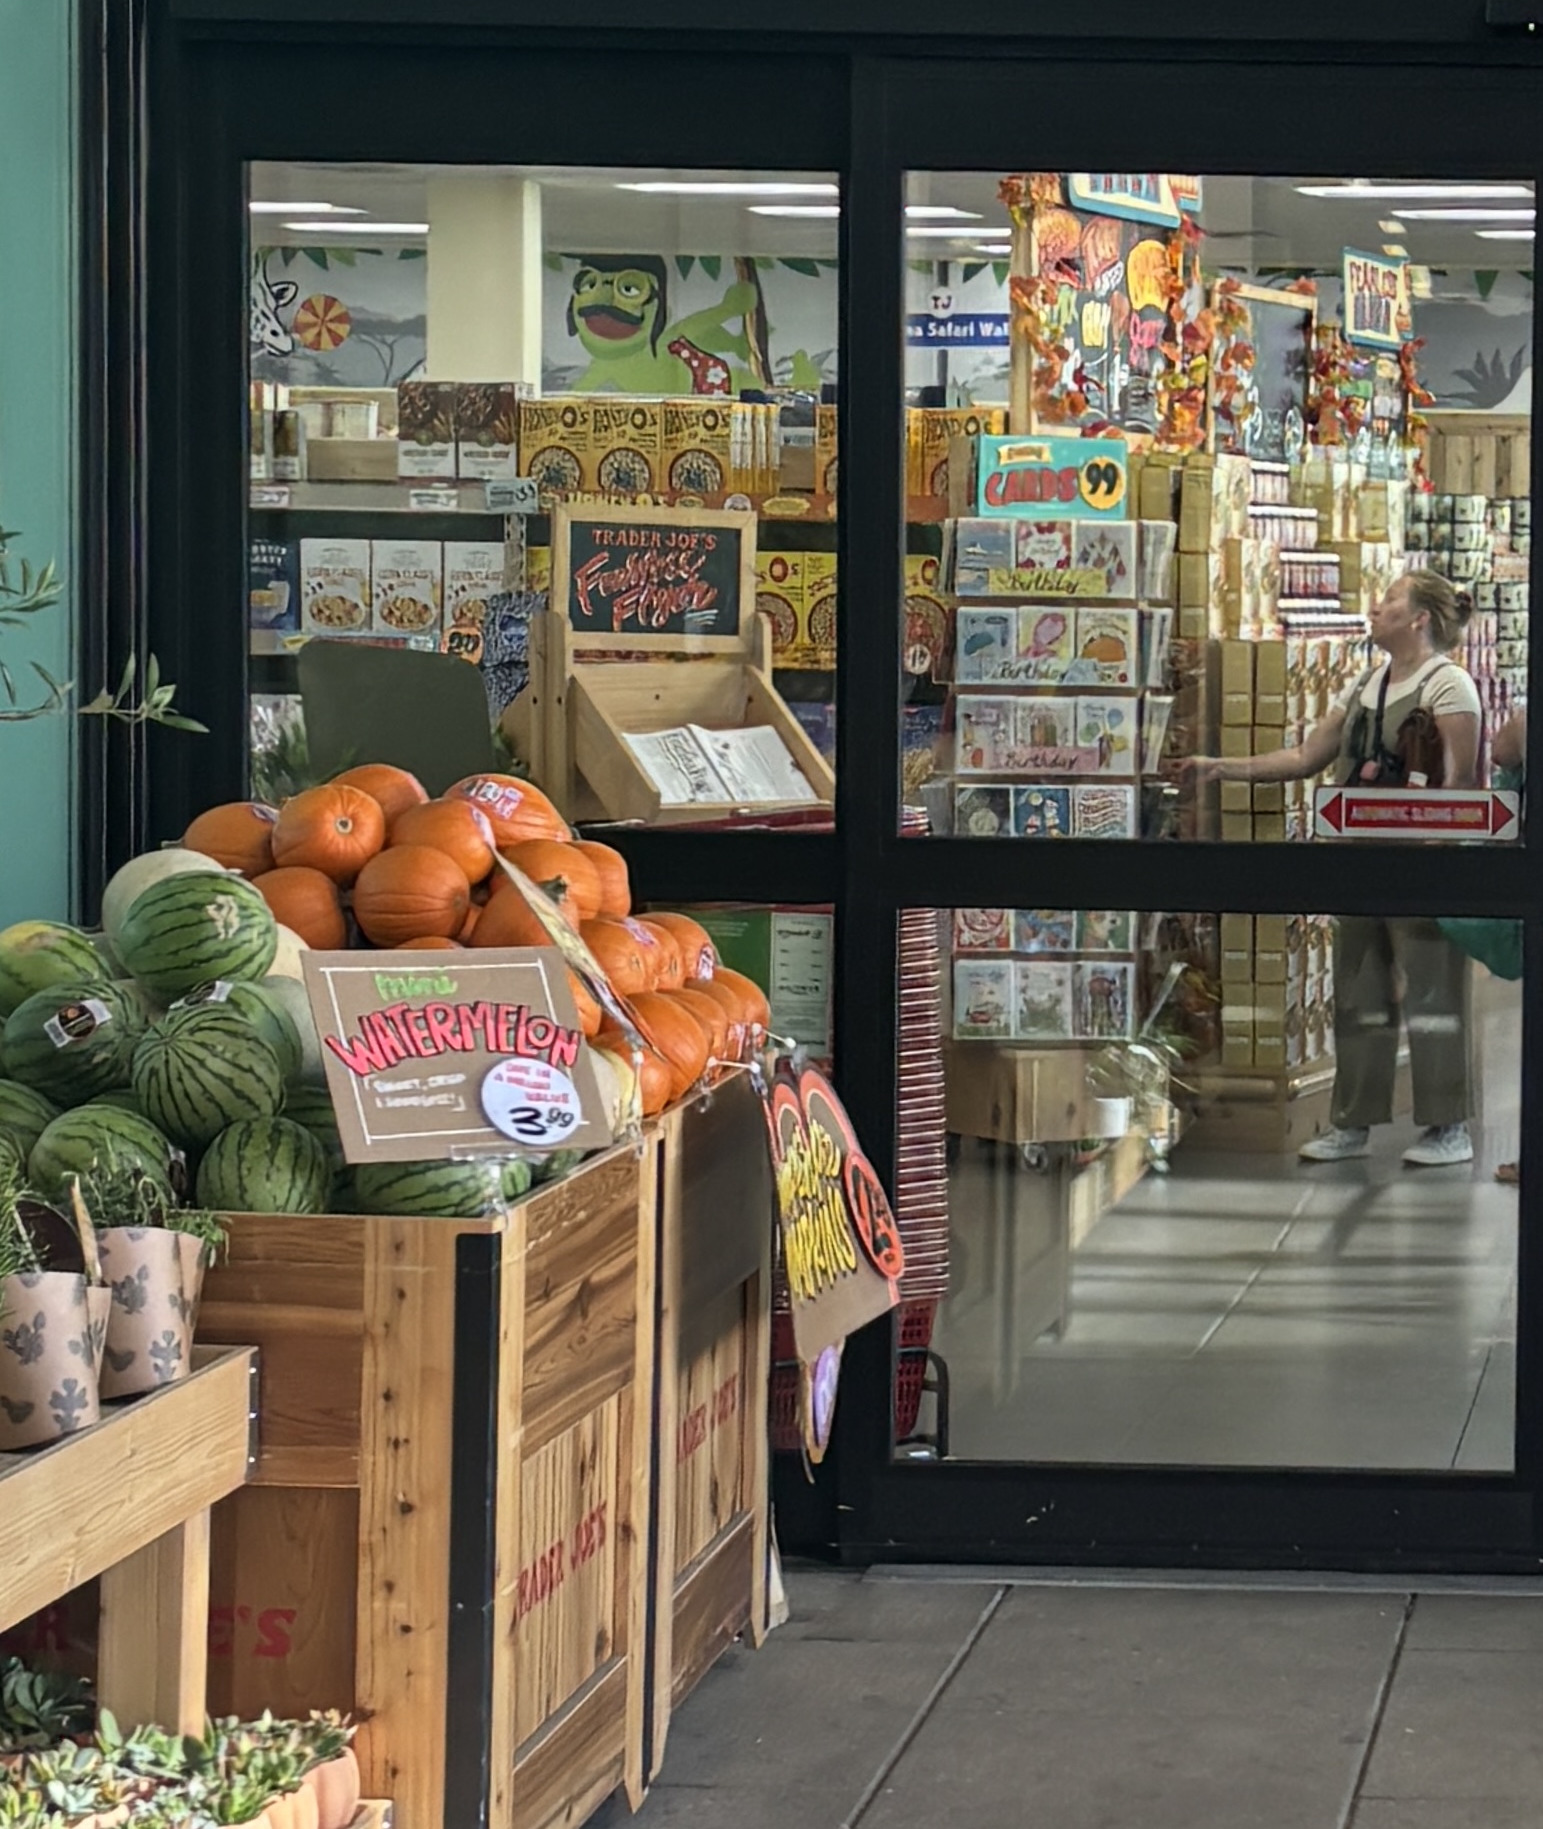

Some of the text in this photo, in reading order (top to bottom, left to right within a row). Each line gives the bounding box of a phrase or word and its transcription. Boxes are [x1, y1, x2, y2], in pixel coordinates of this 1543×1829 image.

[927, 321, 975, 338] Safari
[984, 467, 1078, 507] CARDS
[592, 529, 717, 550] TRADER JOE'S
[1003, 569, 1081, 593] Birthday
[325, 1000, 582, 1078] WATERMELON
